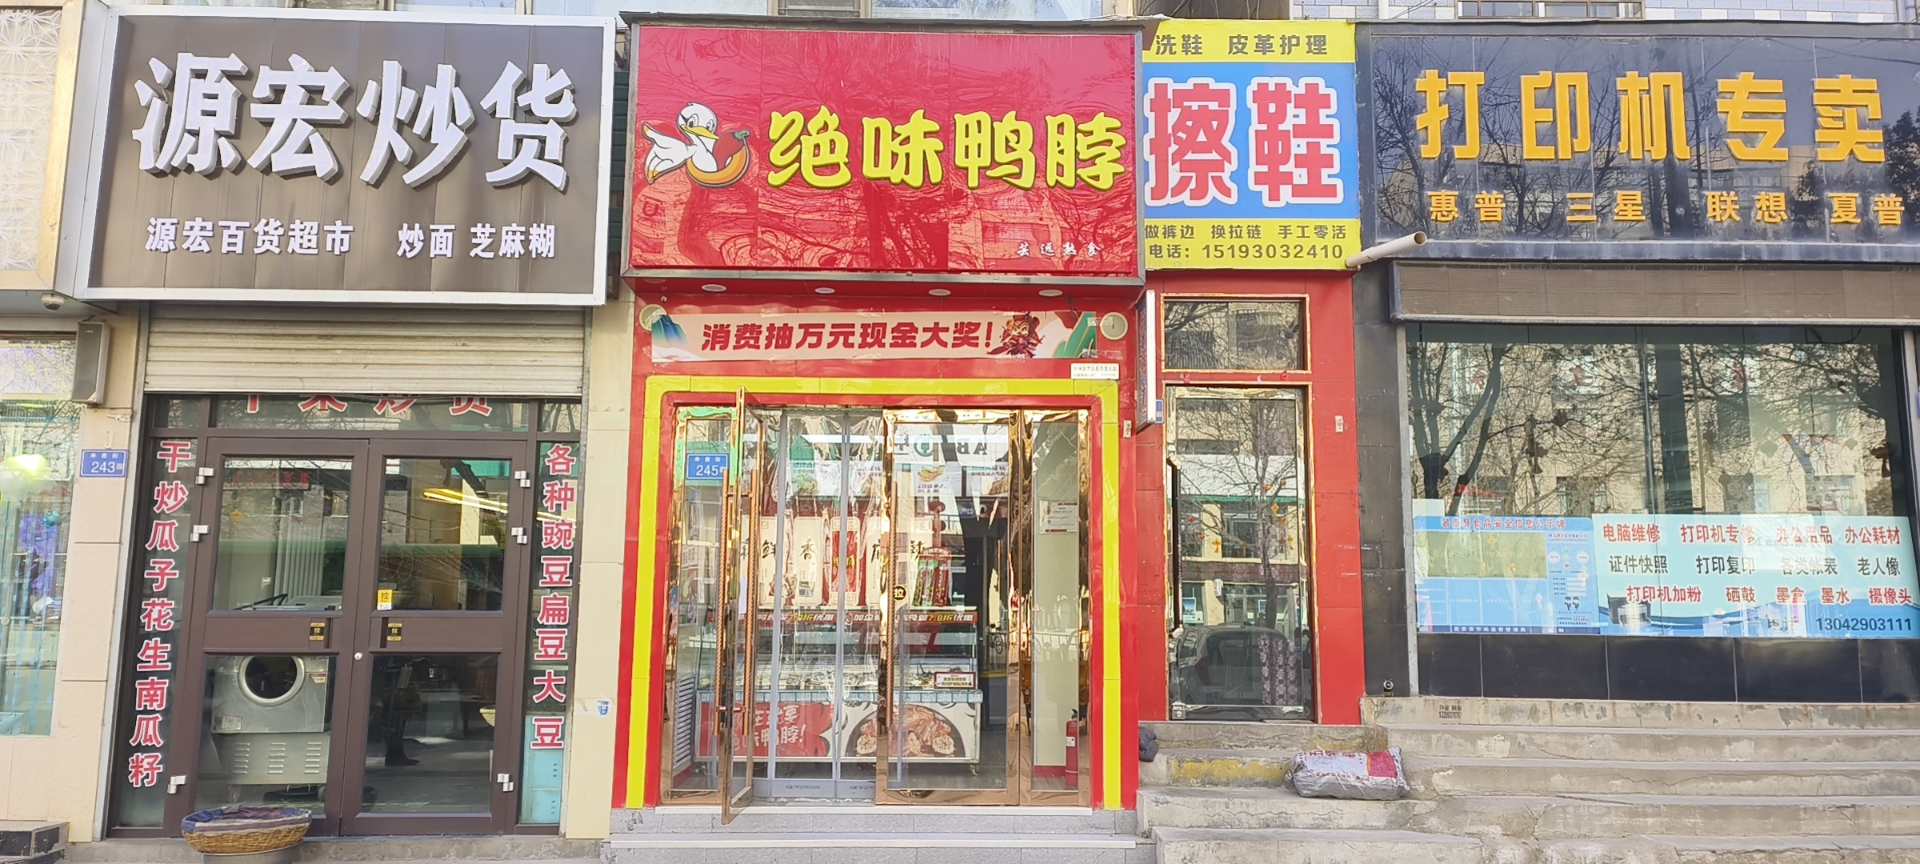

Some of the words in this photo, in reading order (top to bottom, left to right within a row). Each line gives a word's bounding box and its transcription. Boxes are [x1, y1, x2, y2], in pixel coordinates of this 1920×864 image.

[1155, 34, 1203, 56] 洗鞋
[1227, 34, 1328, 56] 皮革护理
[132, 52, 578, 192] 源宏炒货
[1414, 69, 1886, 163] 打印机专卖
[767, 105, 1127, 191] 绝味鸭脖
[1147, 80, 1340, 204] 擦鞋
[1427, 190, 1506, 222] 惠普
[1566, 190, 1646, 222] 三星
[1707, 191, 1788, 223] 联想
[1828, 192, 1905, 226] 夏普
[145, 216, 354, 256] 源宏百货超市
[396, 223, 455, 259] 炒面
[468, 223, 556, 259] 芝麻糊
[1145, 224, 1196, 239] 做裤边
[1210, 224, 1262, 239] 换拉链
[1277, 224, 1347, 239] 手工零活
[701, 320, 992, 352] 消费抽万元现金大奖!
[1603, 523, 1660, 542] 电脑维修
[1680, 523, 1755, 543] 打印机专修
[1776, 525, 1833, 544] 办公用品
[1845, 526, 1900, 545] 办公耗材
[1609, 555, 1668, 573] 证件快照
[1696, 555, 1756, 574] 打印复印
[1857, 557, 1900, 576] 老人像
[529, 444, 578, 750] 各种豌豆扁豆大豆
[1627, 585, 1701, 602] 打印机加粉
[1726, 586, 1756, 602] 硒鼓
[1776, 587, 1806, 604] 墨盒
[1821, 587, 1850, 604] 墨水
[1869, 587, 1912, 604] 摄像头
[127, 440, 192, 789] 干炒瓜子花生南瓜籽
[1816, 618, 1912, 631] 13042903111
